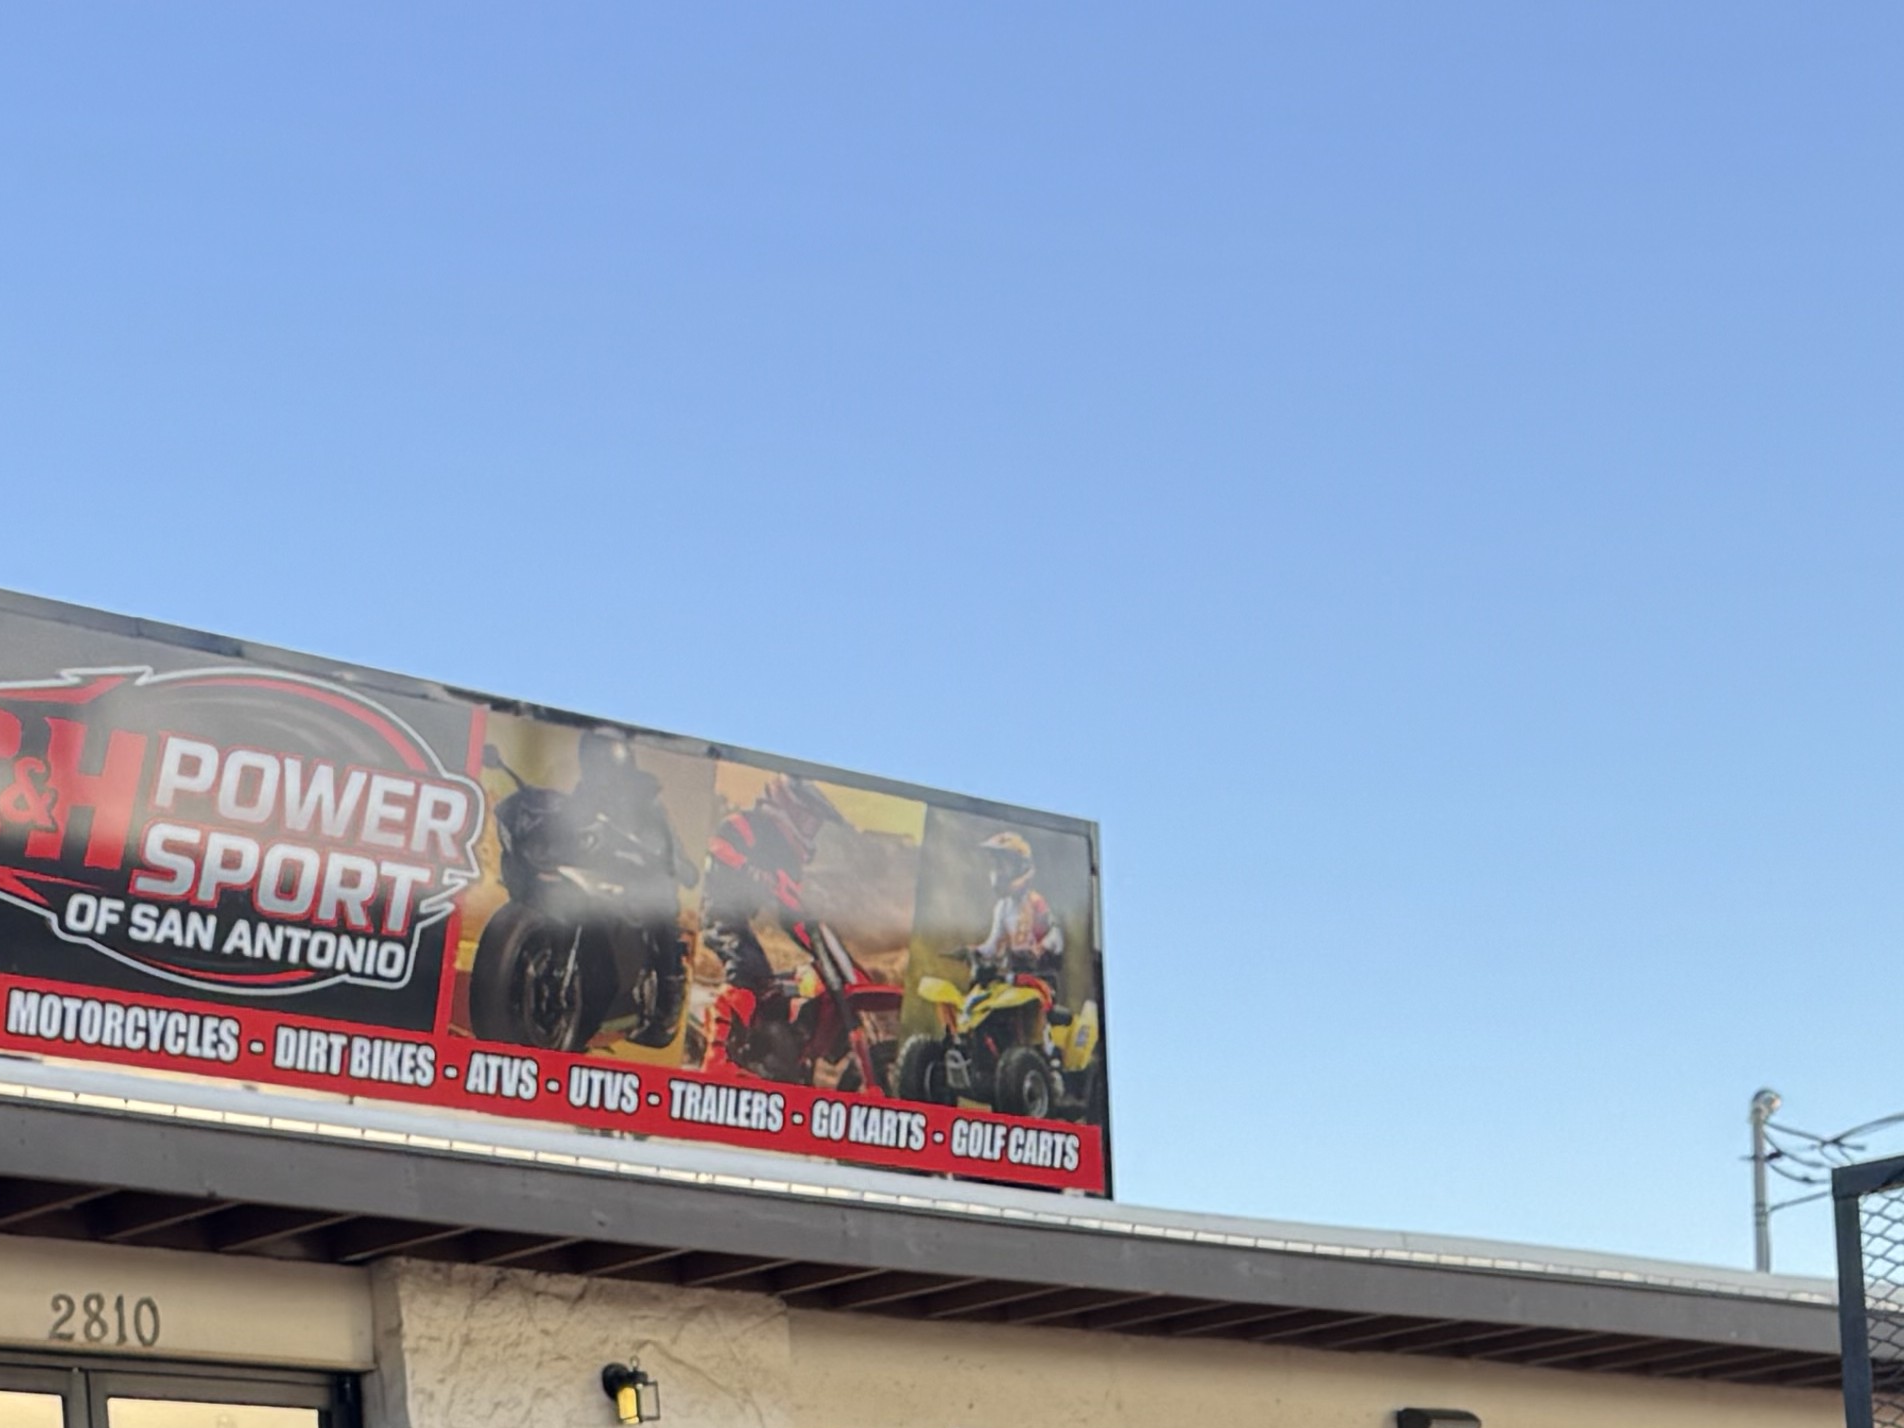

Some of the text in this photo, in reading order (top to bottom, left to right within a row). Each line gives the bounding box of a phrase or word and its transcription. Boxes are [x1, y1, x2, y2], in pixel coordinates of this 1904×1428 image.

[154, 736, 469, 860] POWER
[134, 822, 432, 933] SPORT
[65, 898, 407, 980] OF SAN ANTONIO
[7, 988, 1080, 1172] MOTORCYCLES DIRT BIKES ATVS UTVS TRAILERS GO KARTS GOLF CARTS
[48, 1291, 161, 1347] 2810
